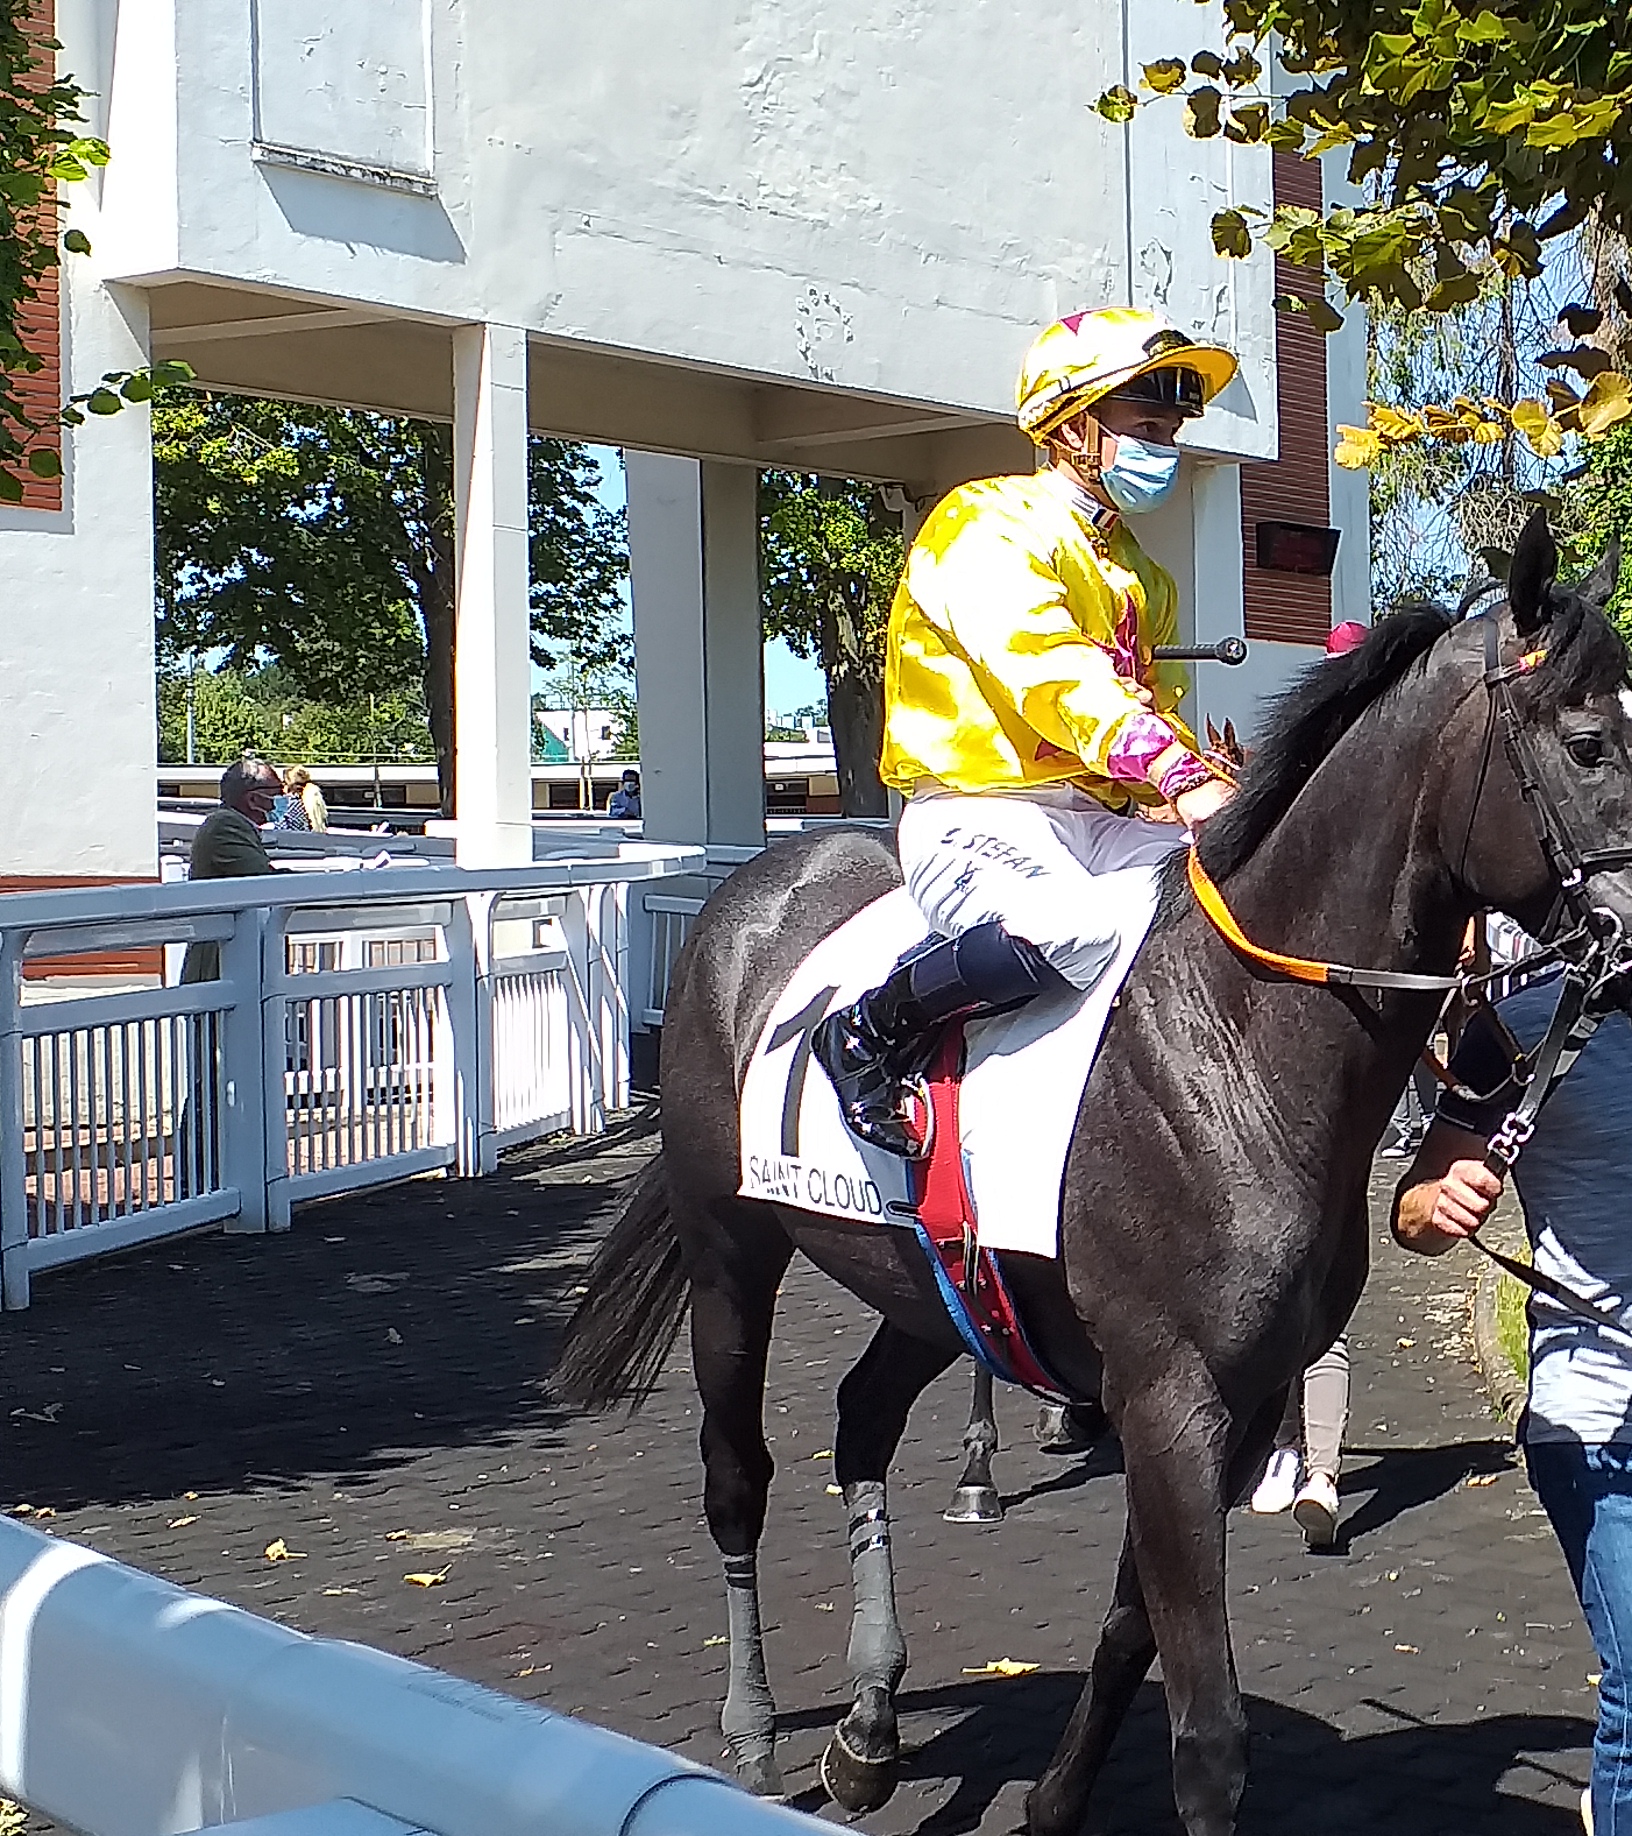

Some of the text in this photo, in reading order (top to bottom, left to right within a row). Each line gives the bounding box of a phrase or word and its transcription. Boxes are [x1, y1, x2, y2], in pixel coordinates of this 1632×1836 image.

[764, 984, 842, 1158] 1
[749, 1155, 883, 1216] SAINT CLOUD
